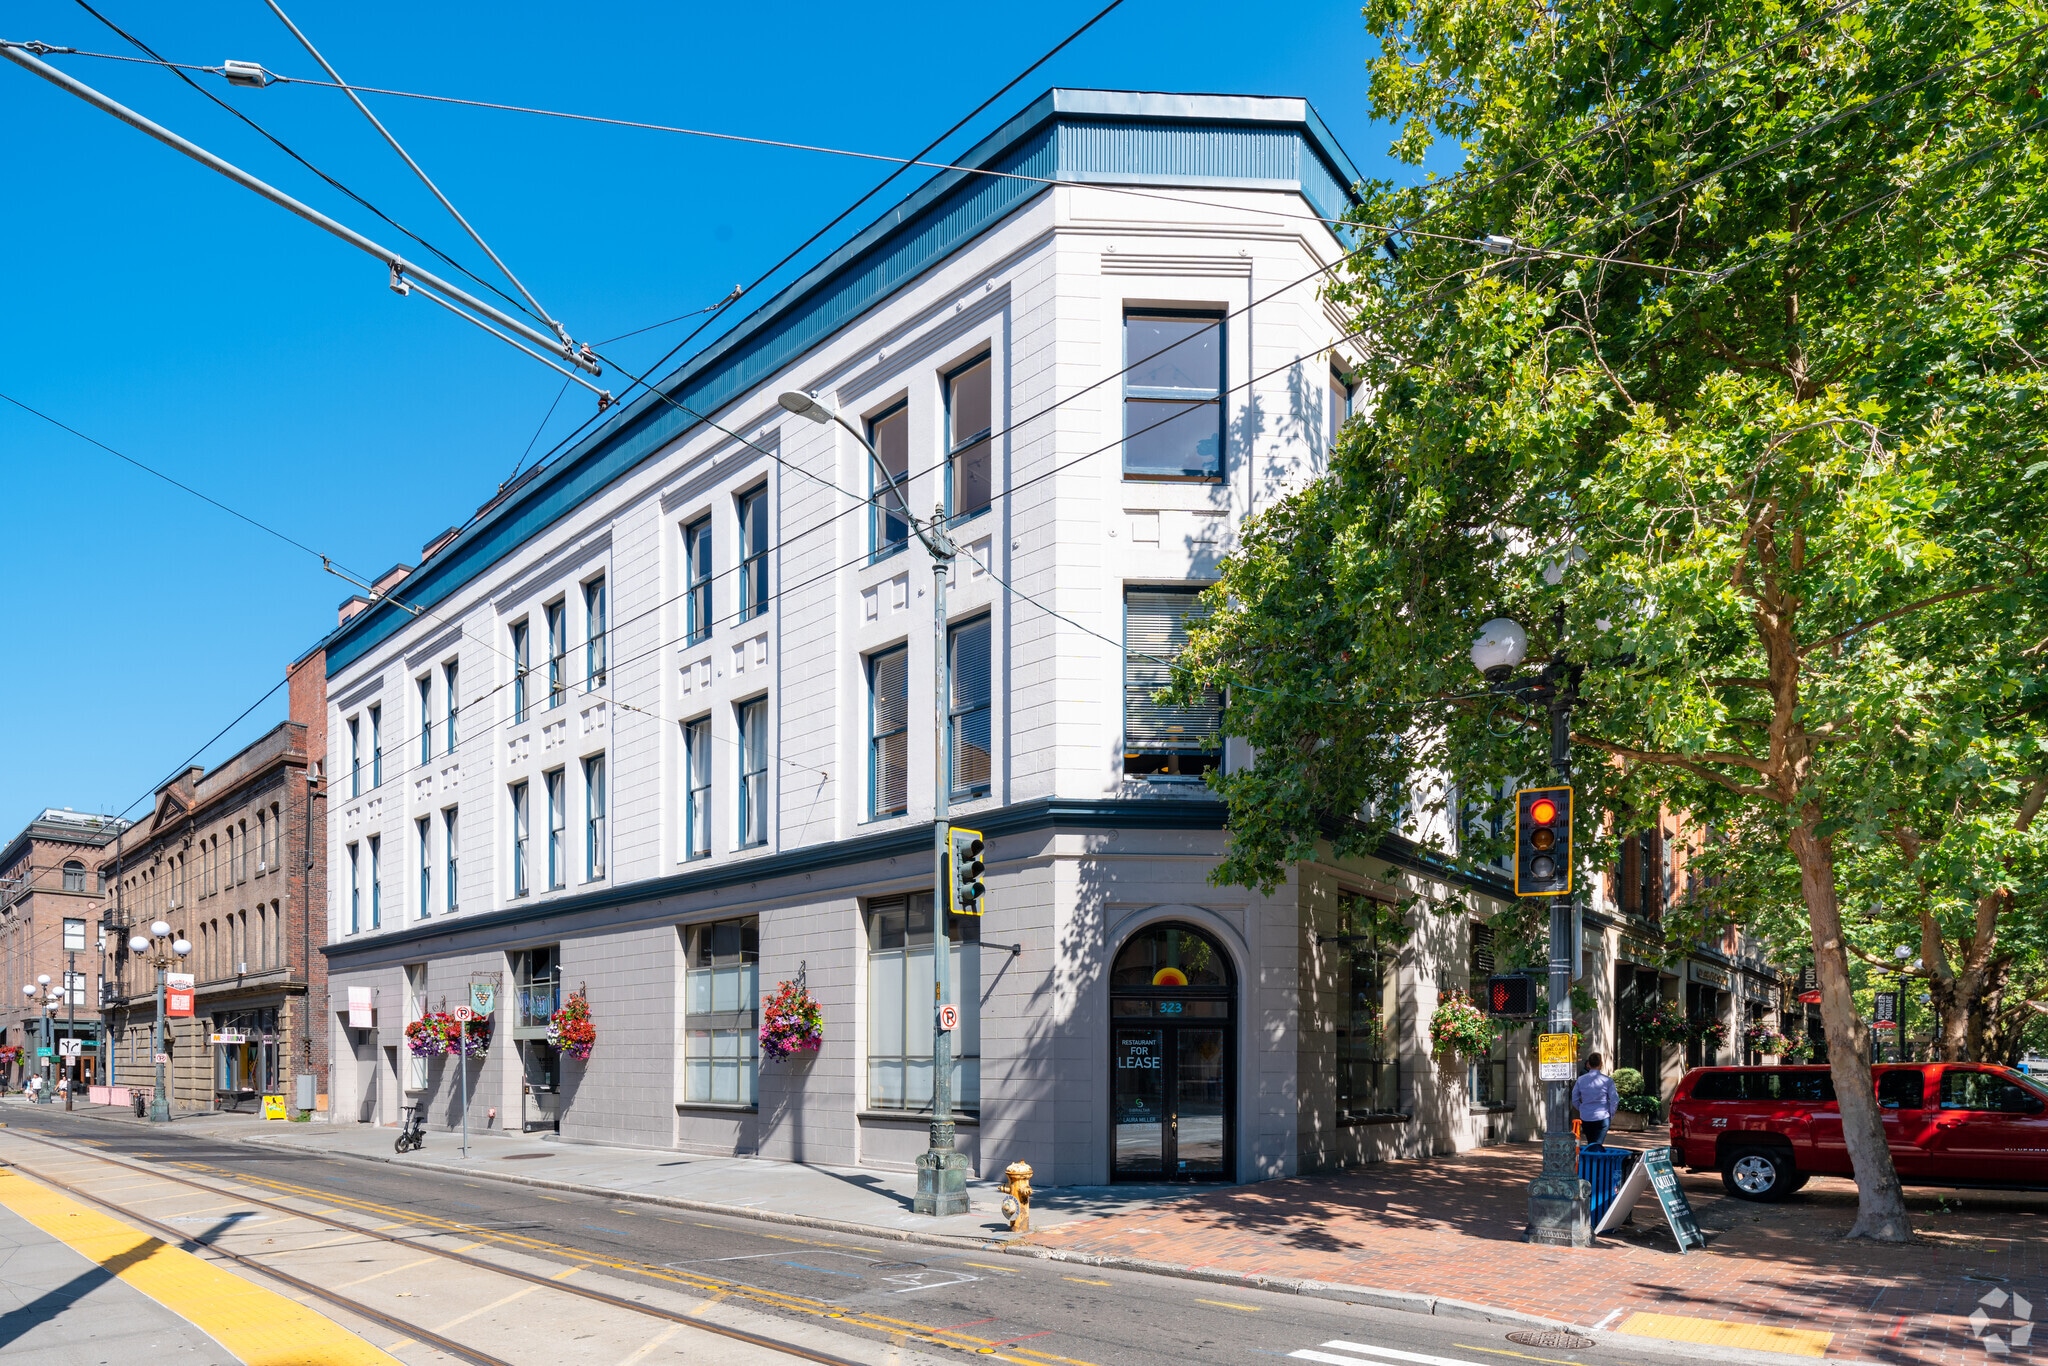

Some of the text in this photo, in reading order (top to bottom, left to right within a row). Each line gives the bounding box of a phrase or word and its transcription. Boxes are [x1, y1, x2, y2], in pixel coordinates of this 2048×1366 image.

[1805, 965, 1815, 989] PION
[1160, 1002, 1182, 1013] 323
[1885, 995, 1893, 1020] SQUARE
[946, 1011, 954, 1024] P
[1130, 1047, 1148, 1055] FOR
[1118, 1057, 1160, 1068] LEASE
[1655, 1174, 1677, 1190] QUILT
